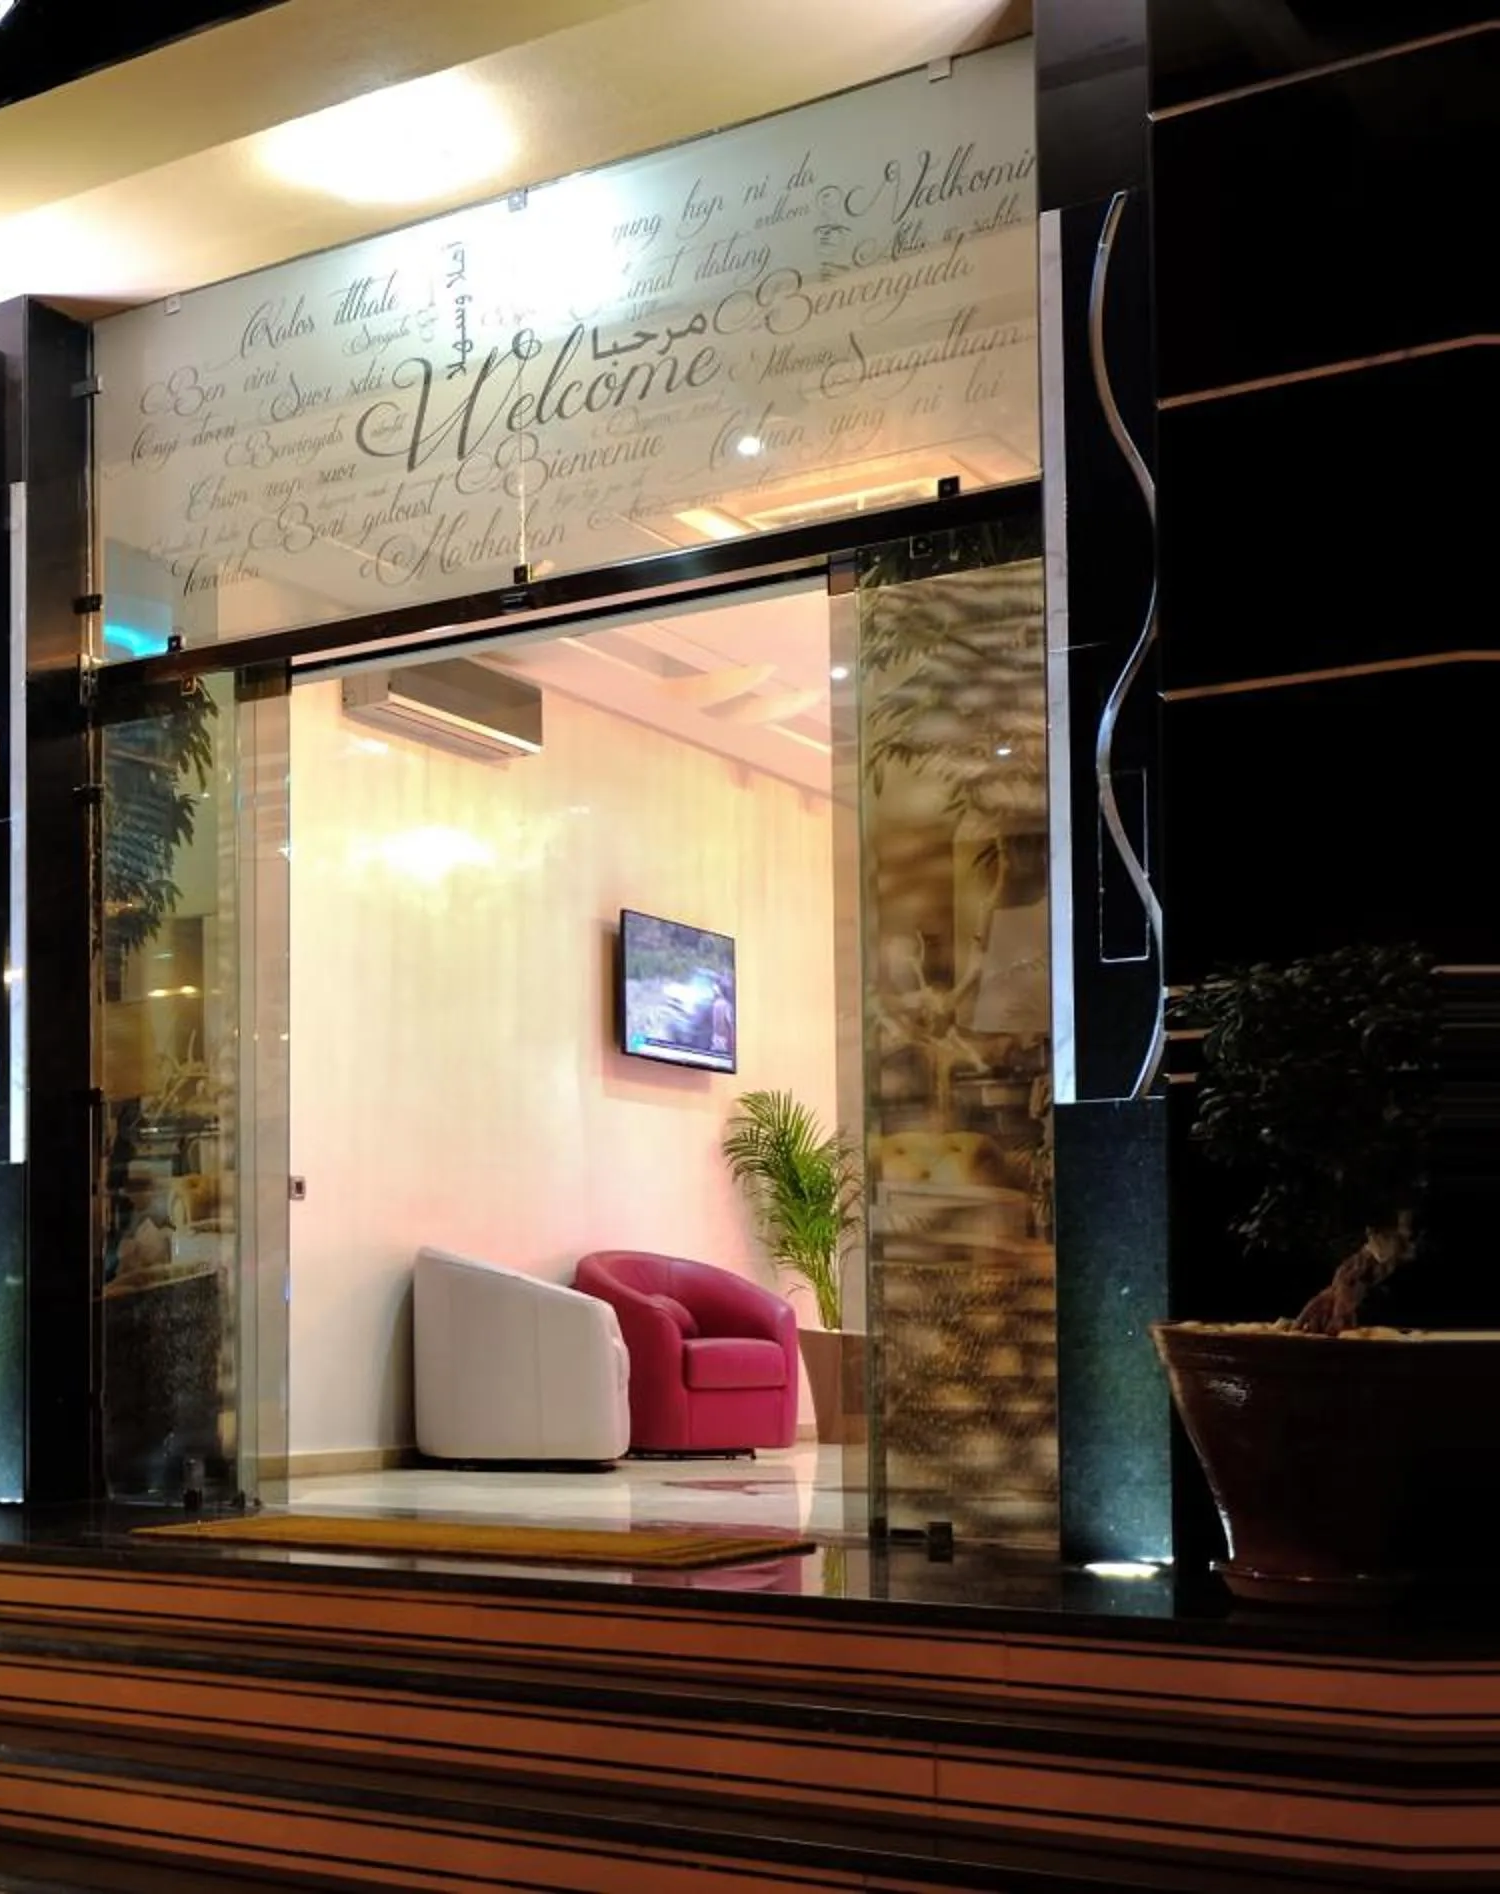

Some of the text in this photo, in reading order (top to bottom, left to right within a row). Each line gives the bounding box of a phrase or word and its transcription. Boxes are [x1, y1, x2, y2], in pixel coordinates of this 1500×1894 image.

[591, 312, 708, 367] مرحبا
[355, 322, 721, 474] Welcome
[456, 431, 665, 498] Bienvenue
